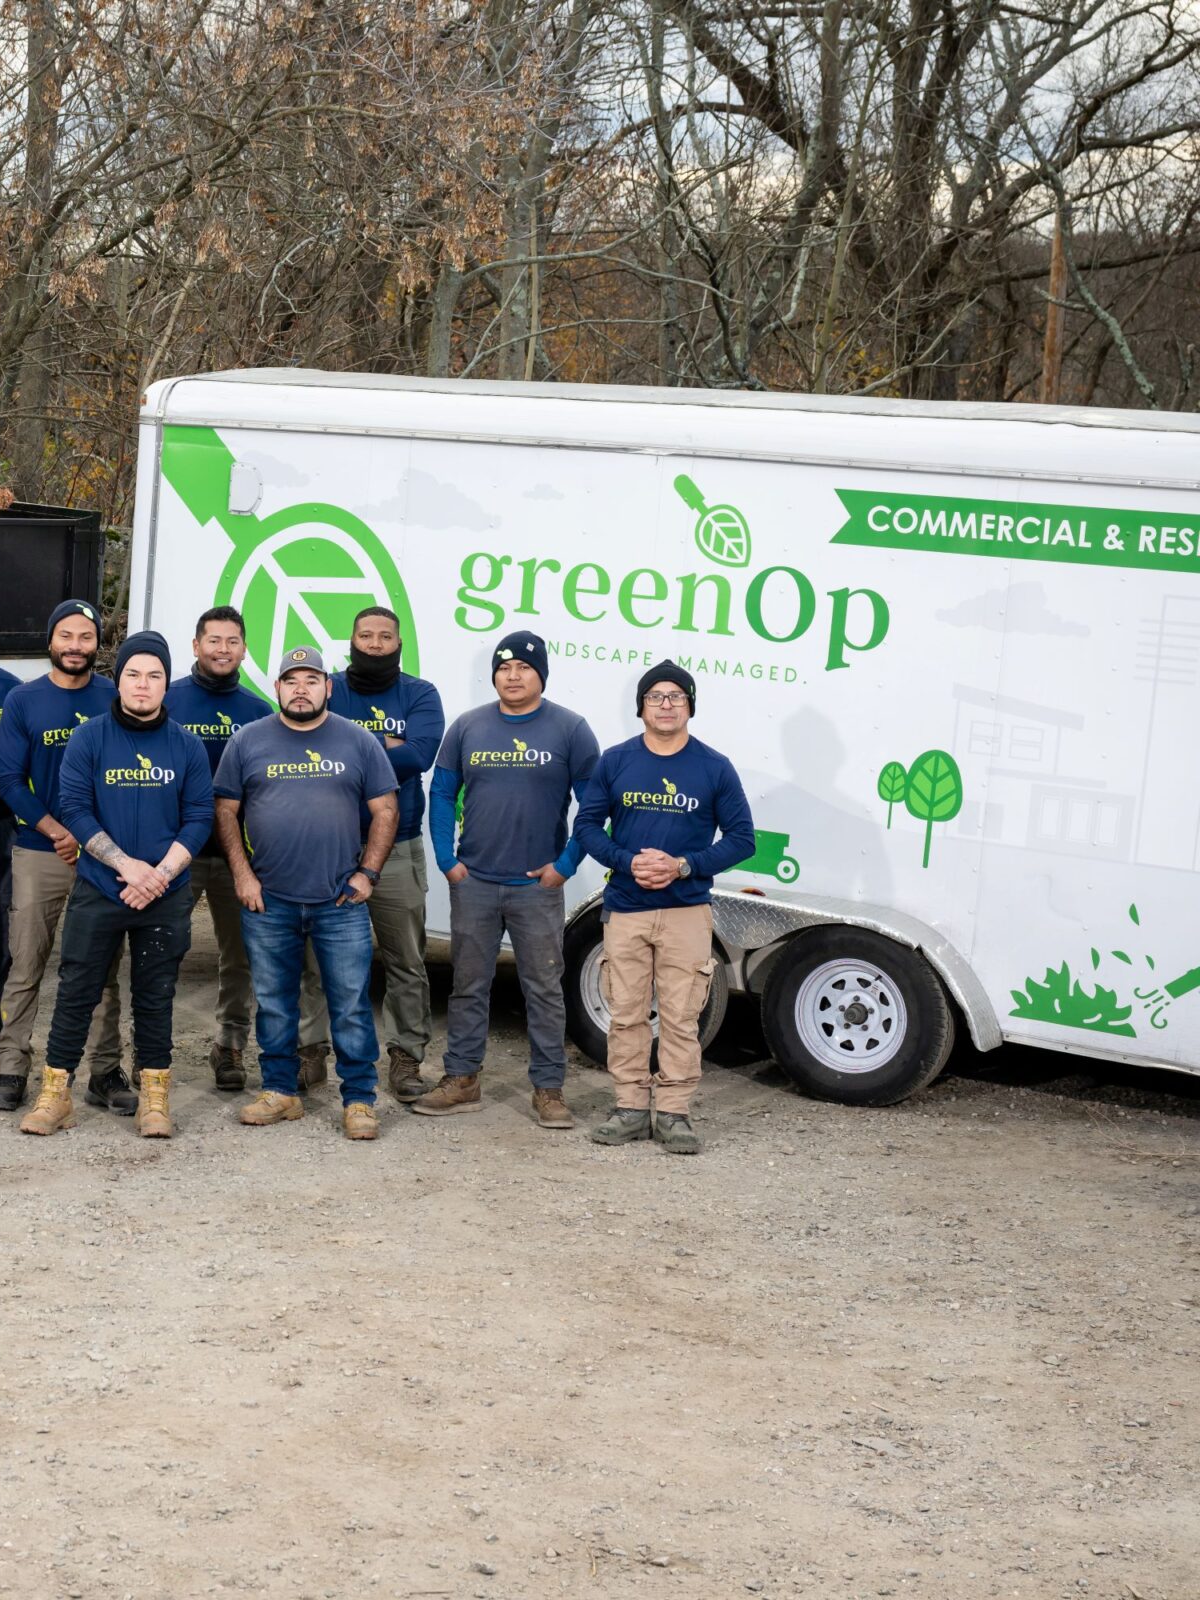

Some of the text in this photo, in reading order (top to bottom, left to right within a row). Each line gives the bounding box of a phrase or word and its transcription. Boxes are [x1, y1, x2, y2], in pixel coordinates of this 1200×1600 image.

[867, 505, 1092, 548] COMMERCIAL
[1102, 524, 1125, 551] &
[454, 552, 890, 671] greenOp
[470, 748, 552, 766] greenOp
[105, 766, 176, 785] greenOp
[266, 759, 346, 778] greenOp
[622, 791, 699, 812] greenOp
